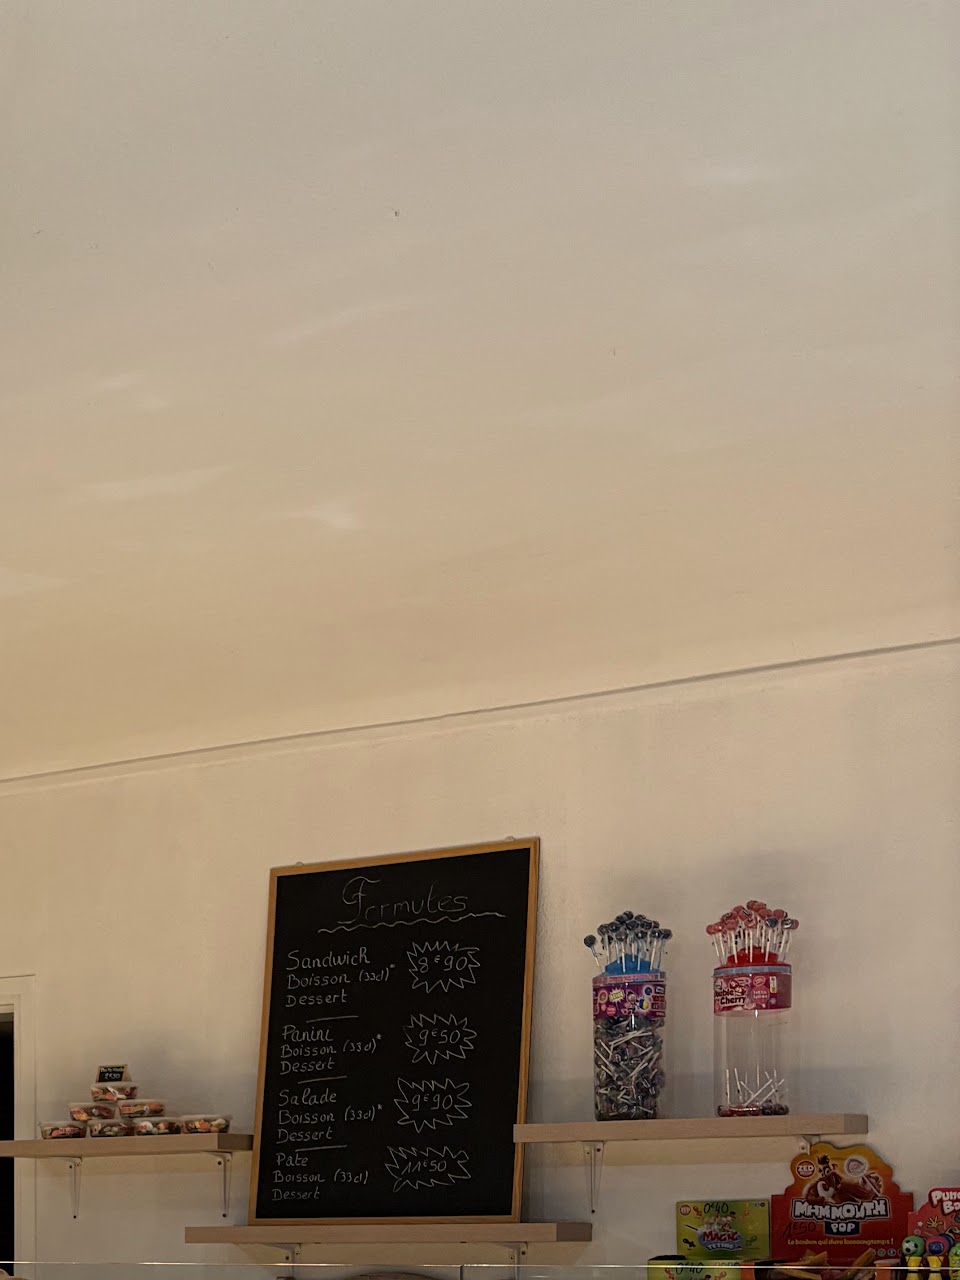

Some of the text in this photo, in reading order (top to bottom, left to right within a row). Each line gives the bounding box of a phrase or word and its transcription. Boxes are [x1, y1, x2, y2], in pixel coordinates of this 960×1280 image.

[285, 946, 371, 971] Sandwich
[286, 973, 351, 990] Boisson
[284, 988, 348, 1008] Dessert
[720, 997, 746, 1005] Cherry
[281, 1023, 334, 1042] Panini
[280, 1043, 337, 1059] Boisson
[279, 1056, 336, 1075] Dessert
[278, 1087, 337, 1107] Salade
[278, 1109, 336, 1125] Boisson
[275, 1126, 333, 1145] Dessert
[275, 1152, 309, 1167] Pâte
[272, 1169, 326, 1183] Boisson
[271, 1186, 321, 1201] Dessert
[793, 1199, 888, 1220] MAMMOUTH
[830, 1222, 856, 1233] POP
[702, 1230, 739, 1242] MAGIC
